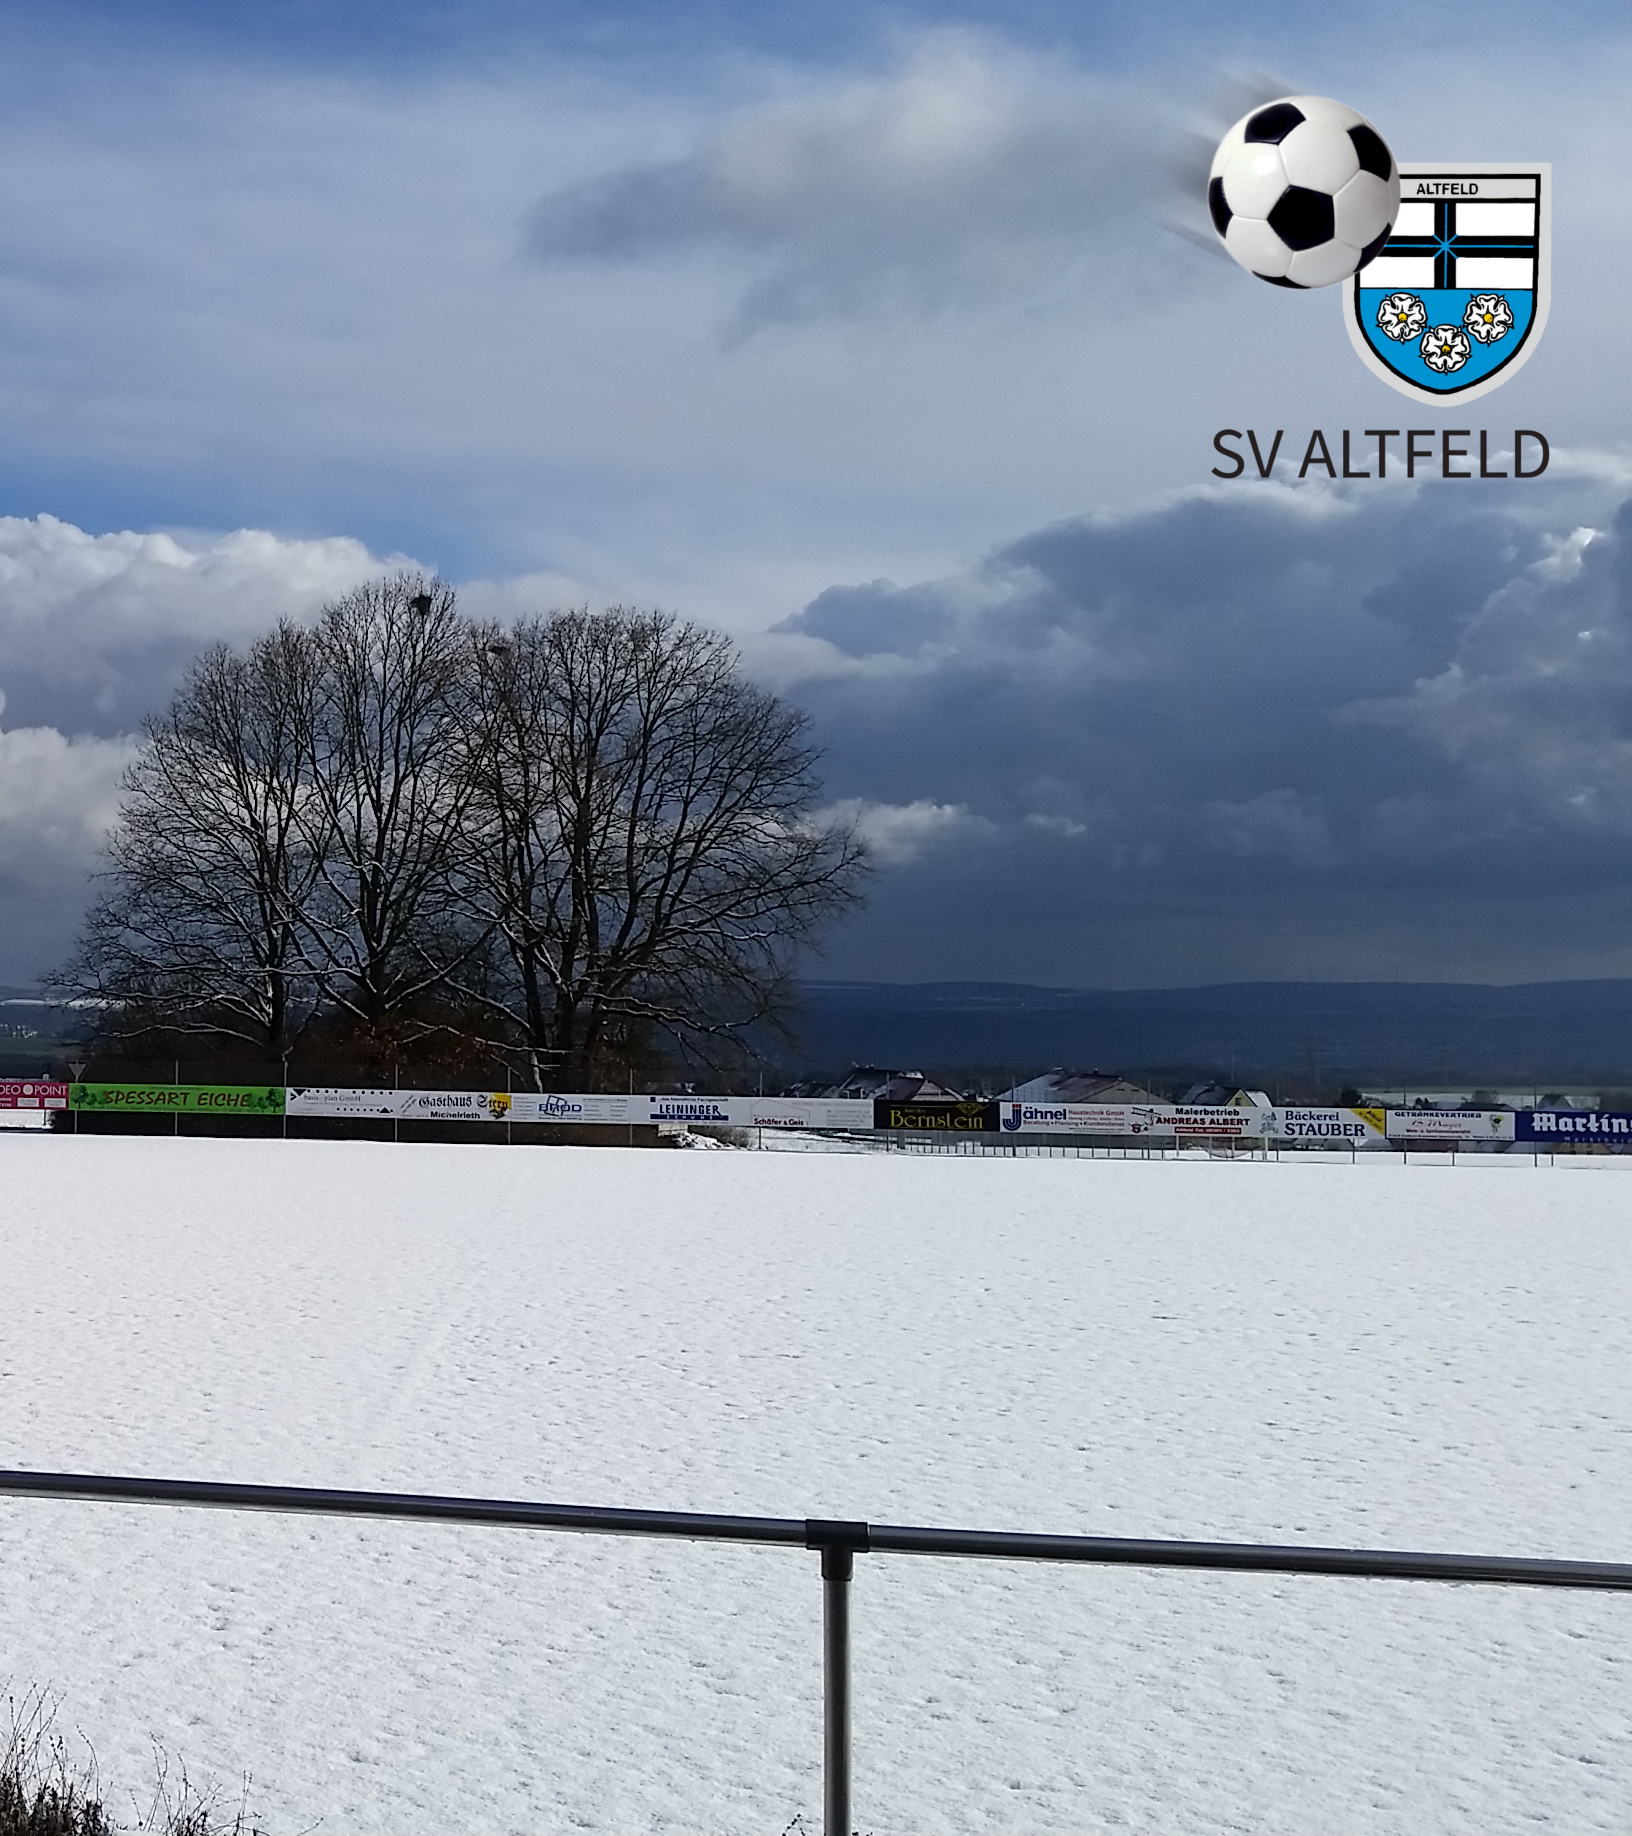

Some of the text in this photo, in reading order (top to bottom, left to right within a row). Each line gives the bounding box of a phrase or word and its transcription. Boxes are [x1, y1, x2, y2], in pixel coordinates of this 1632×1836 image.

[34, 1085, 67, 1096] POINT
[104, 1089, 252, 1108] SPESSART EICHE
[418, 1094, 472, 1108] Gasthaus
[476, 1094, 508, 1111] Stern
[430, 1111, 481, 1119] Michelrieth
[659, 1103, 722, 1116] LEININGER
[1175, 1107, 1240, 1116] Malerbetrieb
[1394, 1110, 1482, 1119] GETRÄNKEVERTRIEB
[889, 1109, 984, 1129] Bernstein
[1285, 1110, 1340, 1121] Bäckerei
[753, 1117, 782, 1126] Schäfer
[788, 1118, 804, 1126] Geis
[1023, 1119, 1050, 1127] Beratung
[1155, 1117, 1251, 1126] ANDREAS ALBERT
[1284, 1122, 1366, 1137] STAUBER
